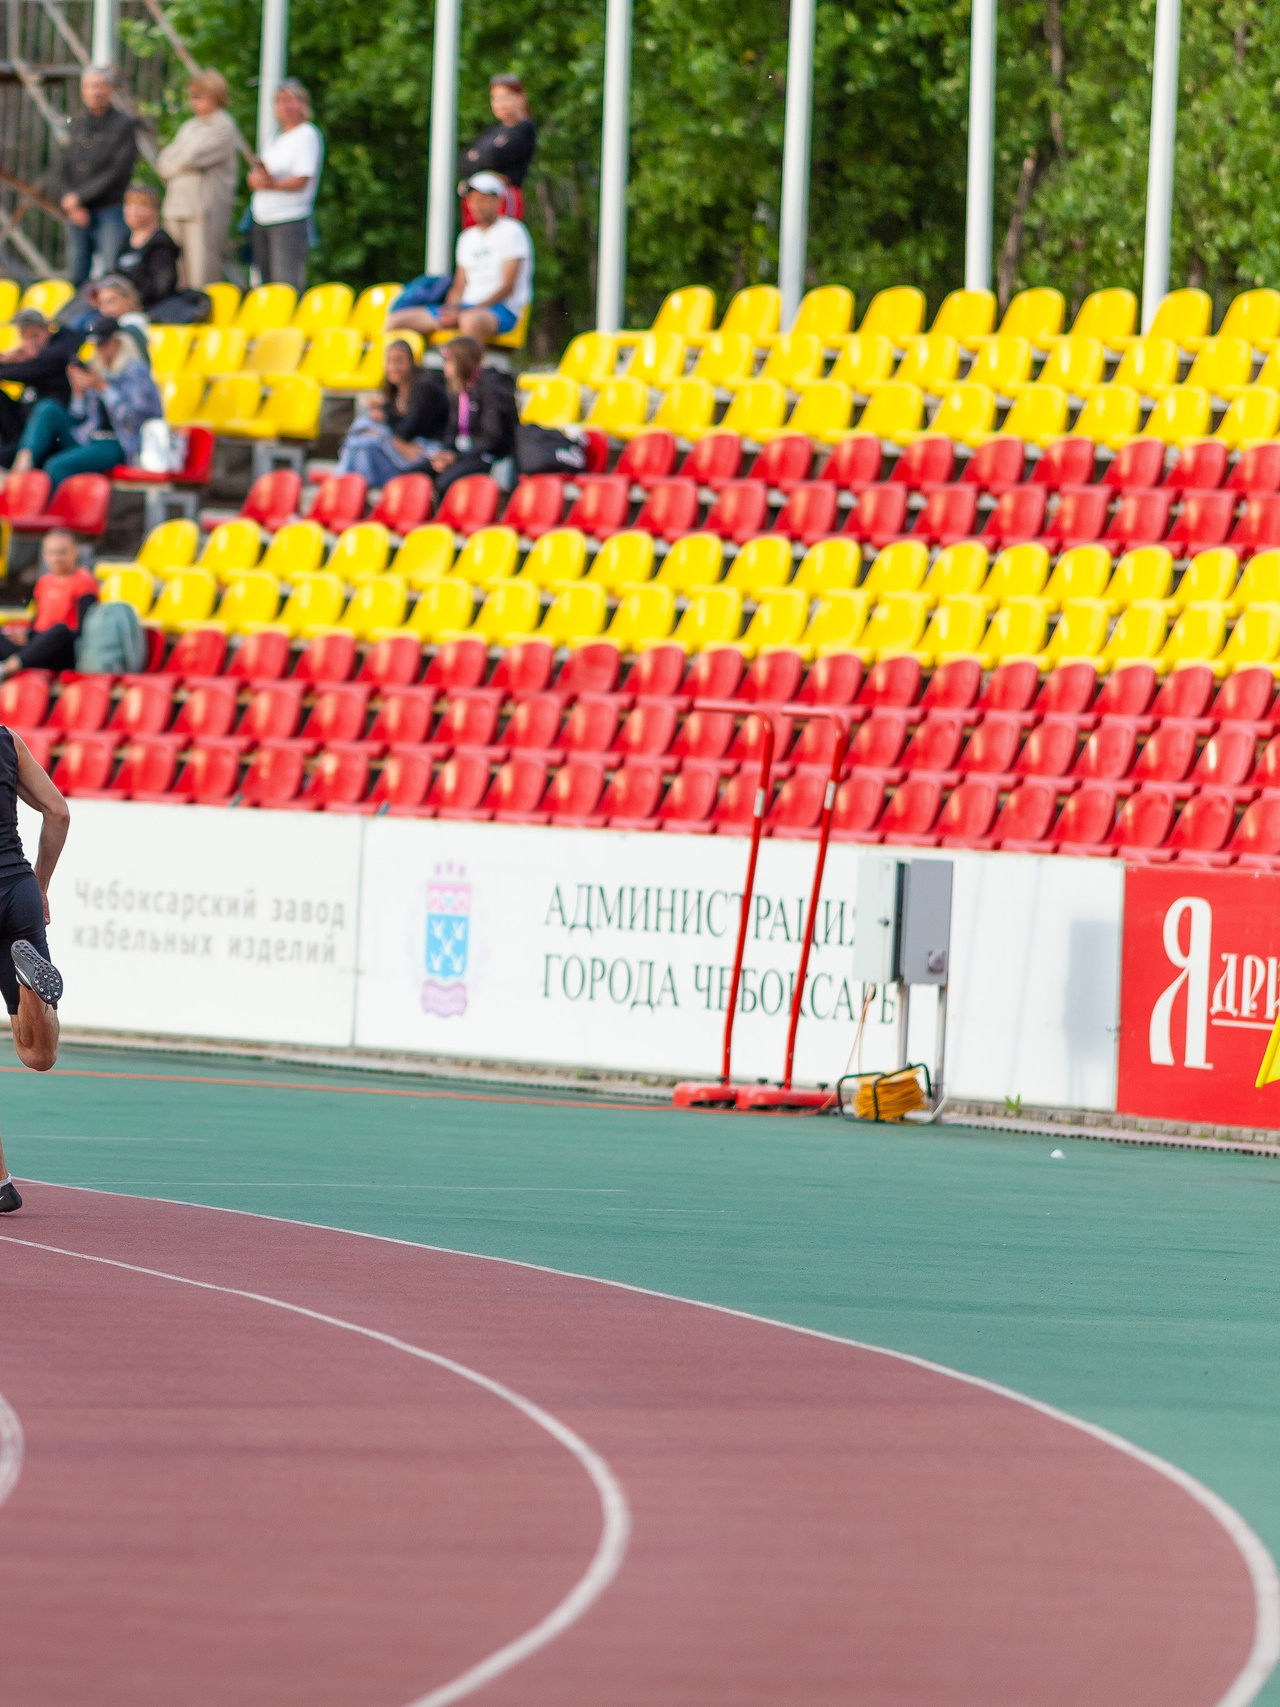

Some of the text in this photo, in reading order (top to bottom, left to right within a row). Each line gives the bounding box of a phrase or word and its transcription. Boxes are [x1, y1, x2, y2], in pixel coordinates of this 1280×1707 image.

[75, 879, 347, 929] Чебоксарский завод
[545, 883, 856, 951] АДМИНИСРАЦИ
[72, 921, 336, 964] кабельных изделий
[542, 952, 680, 1015] ГОРОДА
